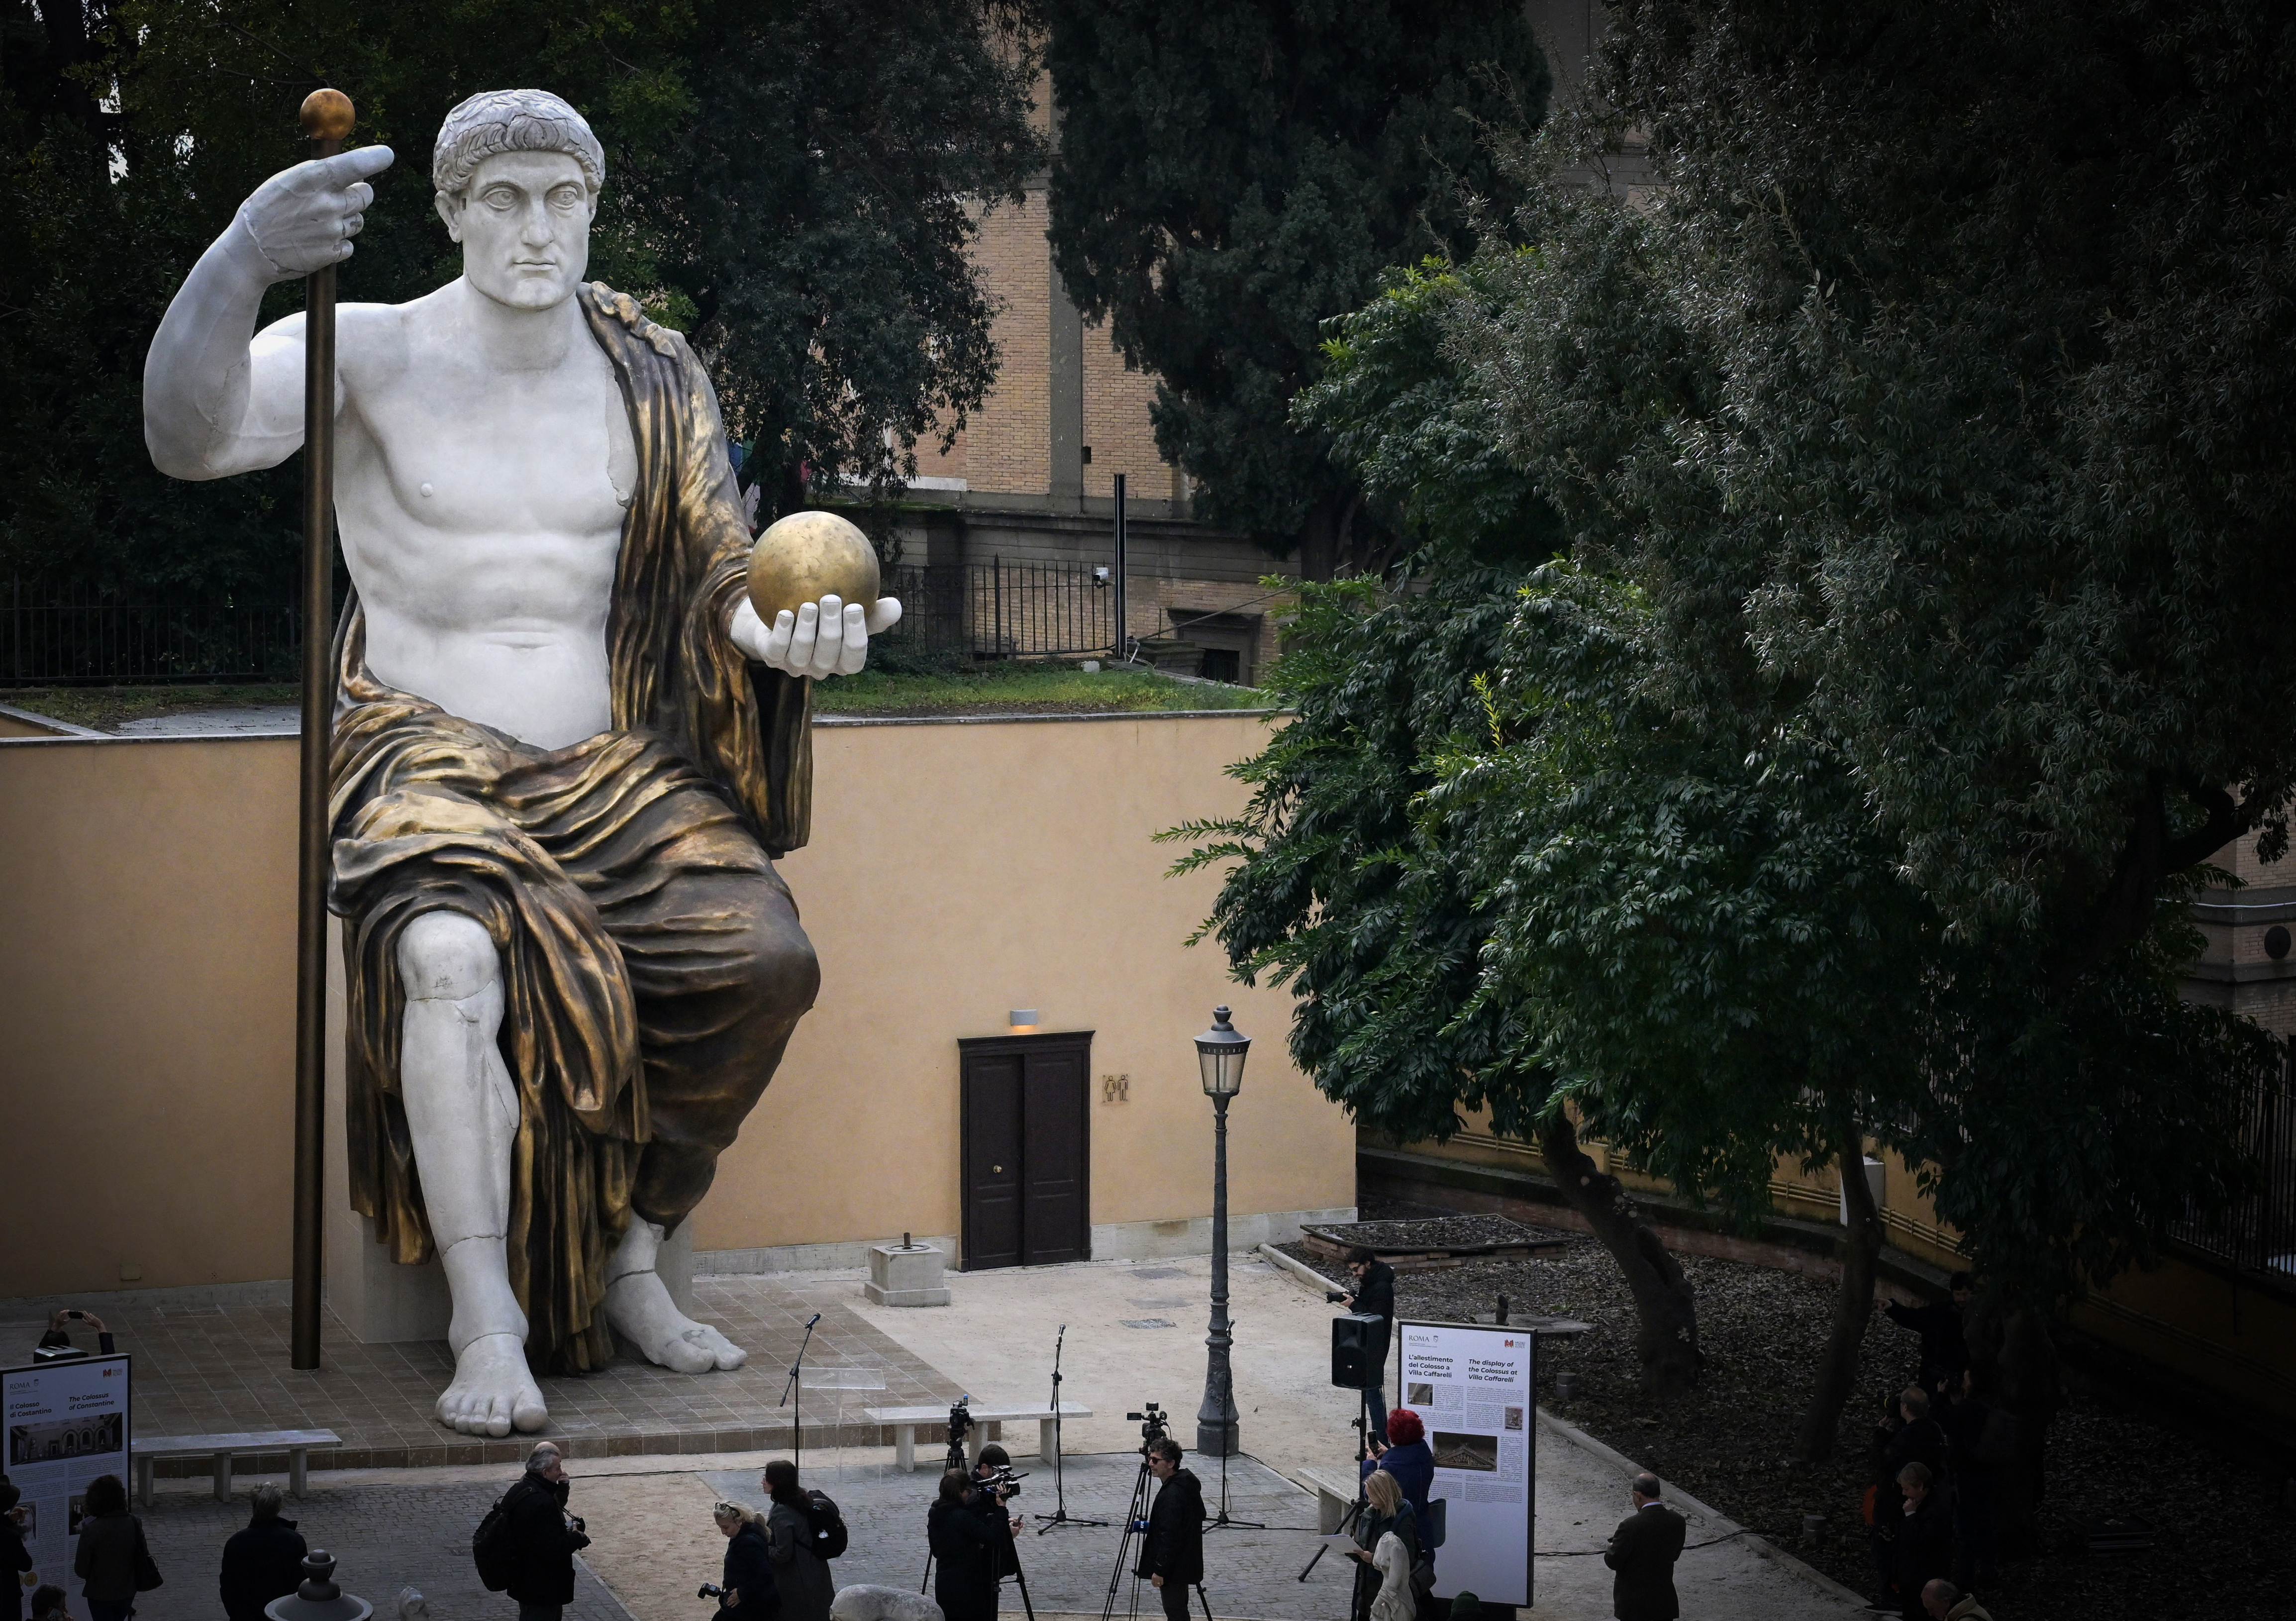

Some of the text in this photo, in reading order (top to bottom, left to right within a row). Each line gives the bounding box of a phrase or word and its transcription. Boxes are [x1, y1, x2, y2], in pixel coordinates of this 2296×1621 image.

[1409, 1354, 1453, 1363] L'allestimento
[77, 1400, 114, 1410] Constantine
[17, 1408, 52, 1417] Costantino
